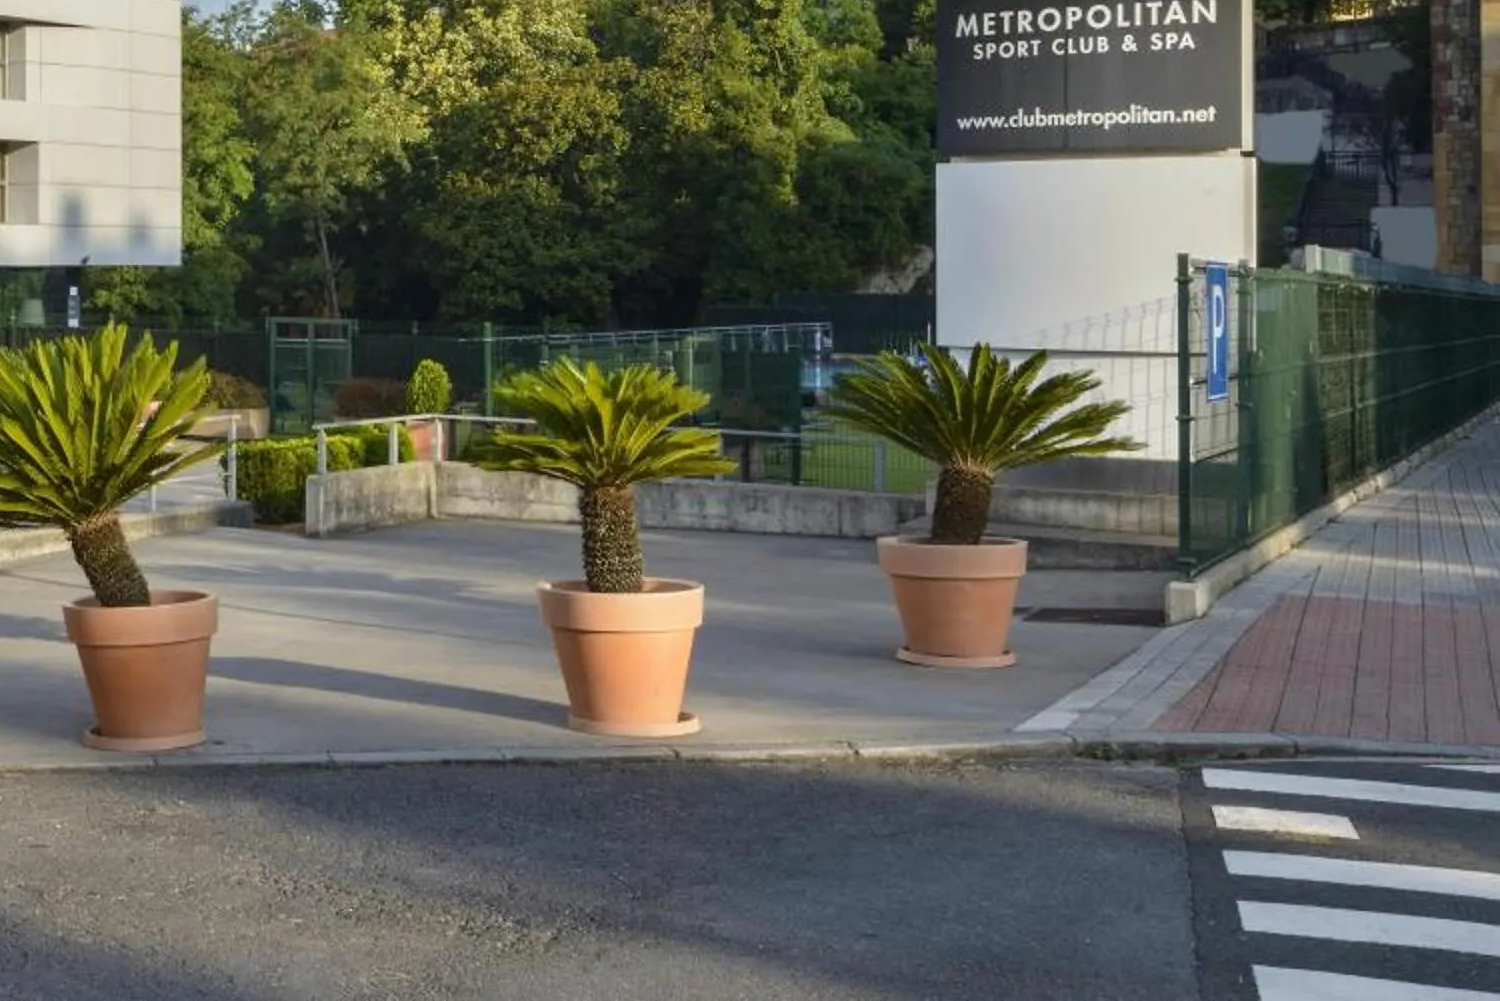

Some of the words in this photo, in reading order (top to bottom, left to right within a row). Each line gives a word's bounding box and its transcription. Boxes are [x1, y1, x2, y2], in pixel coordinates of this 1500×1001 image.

[973, 39, 1042, 61] SPORT
[1051, 36, 1109, 56] CLUB
[1121, 34, 1138, 52] &
[1150, 32, 1196, 50] SPA
[956, 104, 1217, 130] www.clubmetropolitan.net
[1211, 284, 1225, 375] P
